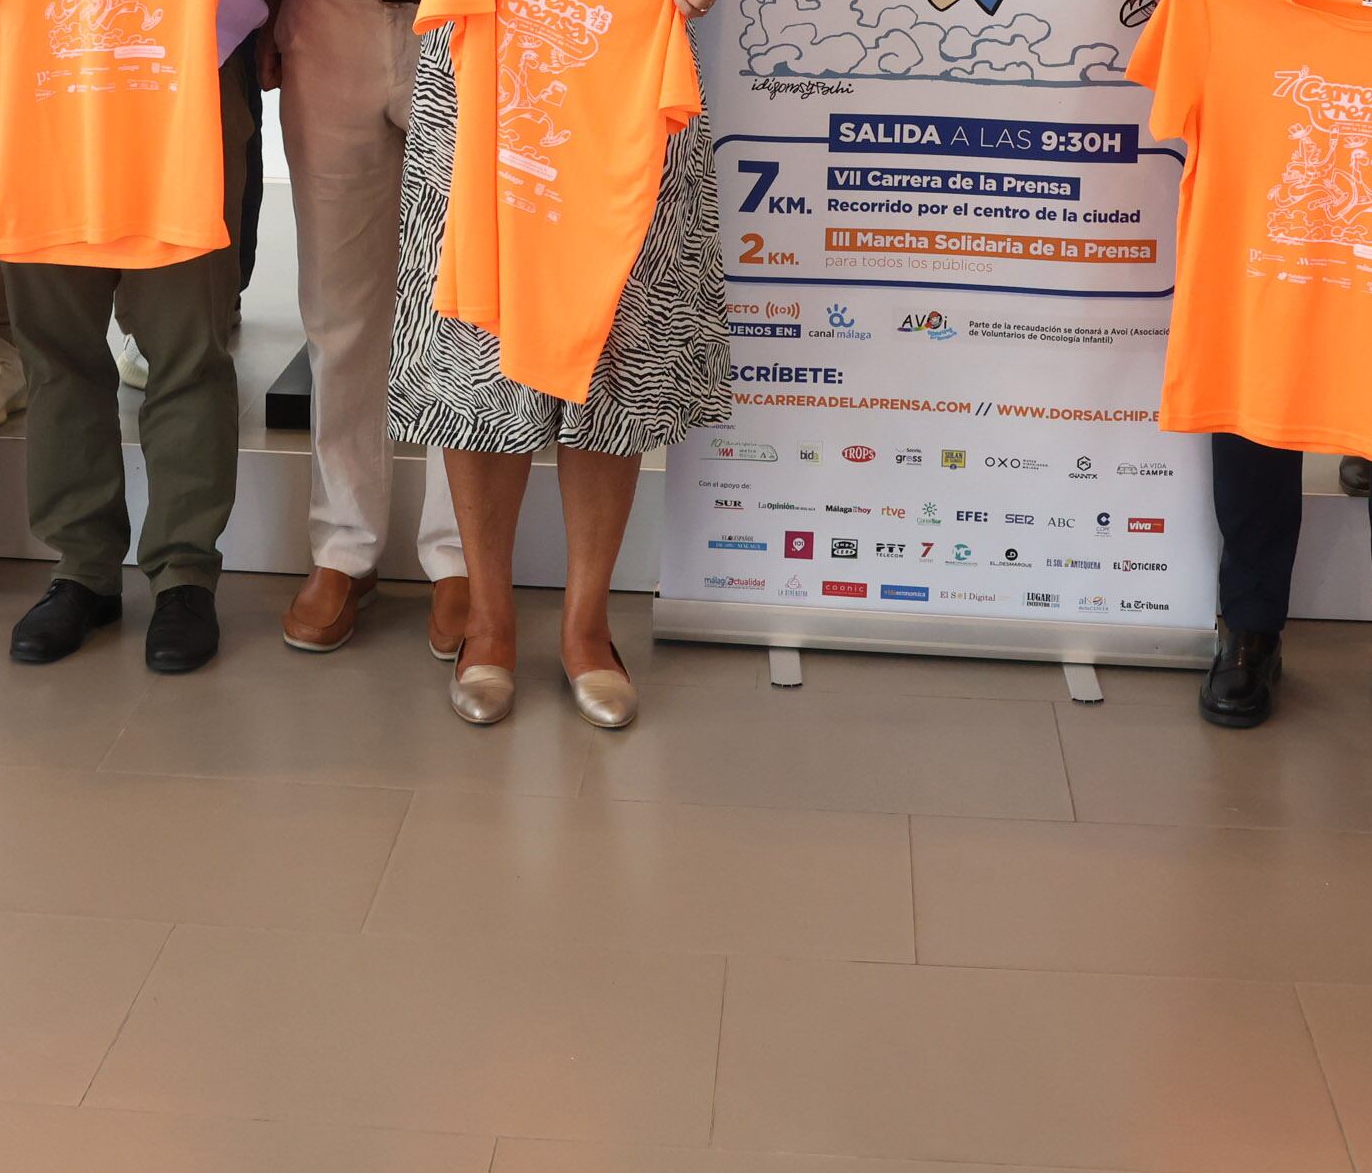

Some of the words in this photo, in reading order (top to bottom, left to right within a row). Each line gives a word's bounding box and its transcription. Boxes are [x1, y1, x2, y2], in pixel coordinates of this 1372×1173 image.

[839, 123, 940, 146] SALIDA
[951, 126, 970, 147] A
[980, 127, 1032, 150] LAS
[1041, 130, 1121, 153] 9:30H
[738, 161, 780, 213] 7
[769, 197, 812, 215] KM.
[834, 170, 861, 186] VII
[867, 171, 943, 191] Carrera
[948, 173, 974, 190] de
[979, 175, 998, 192] la
[1004, 176, 1071, 196] Prensa
[828, 199, 913, 215] Recorrido
[918, 204, 948, 218] por
[953, 201, 969, 216] el
[973, 205, 1031, 220] centro
[1035, 206, 1057, 221] de
[1062, 206, 1078, 222] la
[1082, 208, 1140, 224] ciudad
[739, 234, 764, 264] 2
[768, 250, 799, 265] KM.
[832, 232, 850, 247] III
[856, 233, 928, 250] Marcha
[935, 235, 1023, 255] Solidaria
[1028, 238, 1055, 256] de
[1059, 240, 1077, 256] la
[1083, 242, 1151, 259] Prensa
[825, 256, 855, 270] para
[858, 255, 903, 269] todos
[908, 256, 927, 270] los
[933, 256, 993, 274] públicos
[776, 327, 796, 336] EN:
[808, 330, 834, 338] canal
[837, 329, 871, 340] málaga
[969, 321, 989, 329] Parte
[1004, 322, 1011, 330] la
[1013, 324, 1061, 333] recaudación
[1075, 327, 1102, 335] donará
[982, 330, 1025, 339] Voluntarios
[1040, 334, 1080, 343] Oncología
[1083, 336, 1113, 344] Infantil)
[715, 499, 742, 507] SUR
[826, 505, 852, 514] Málaga
[881, 506, 905, 518] rtve
[1048, 517, 1075, 528] ABC
[1122, 560, 1167, 571] NOTICIERO
